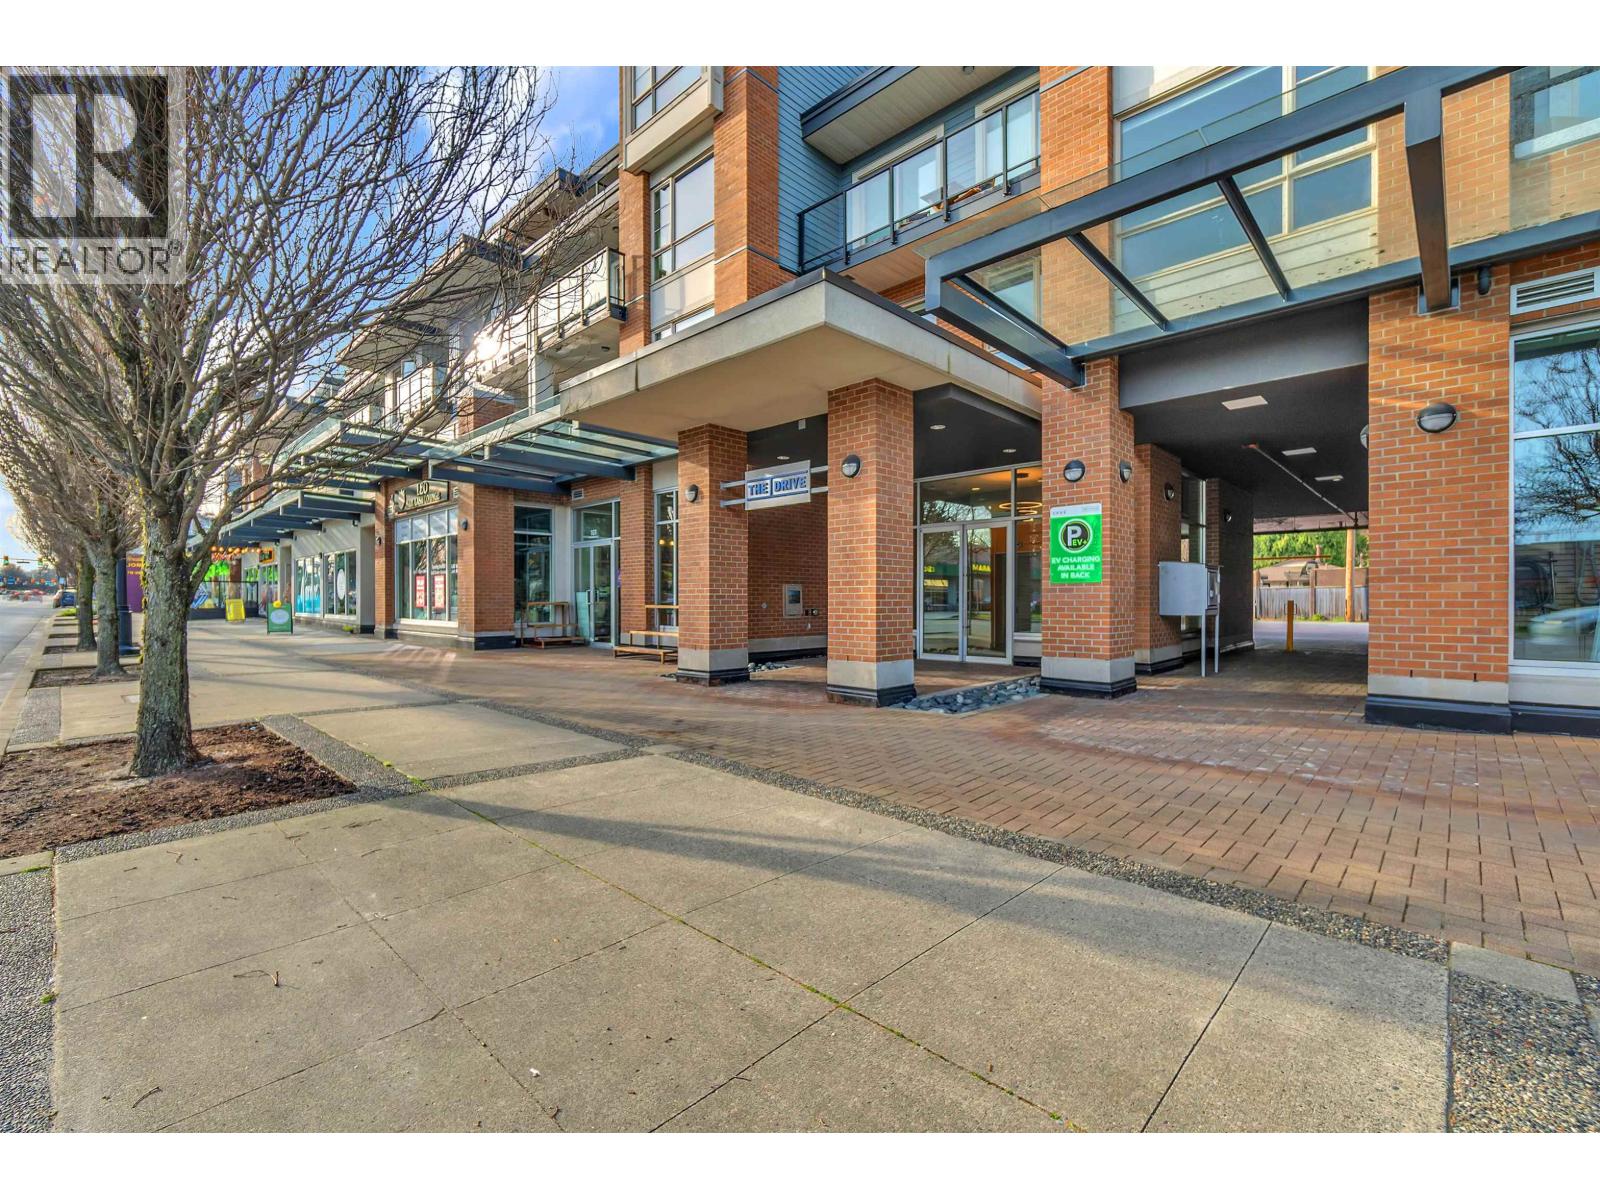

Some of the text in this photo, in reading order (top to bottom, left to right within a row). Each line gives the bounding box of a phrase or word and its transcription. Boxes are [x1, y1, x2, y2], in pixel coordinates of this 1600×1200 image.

[417, 481, 430, 496] LEO
[748, 476, 807, 496] THE DRIVE
[1067, 525, 1082, 547] P
[1062, 555, 1101, 564] CHARGING
[1057, 563, 1095, 571] AVAILABLE
[1070, 571, 1090, 579] BACK
